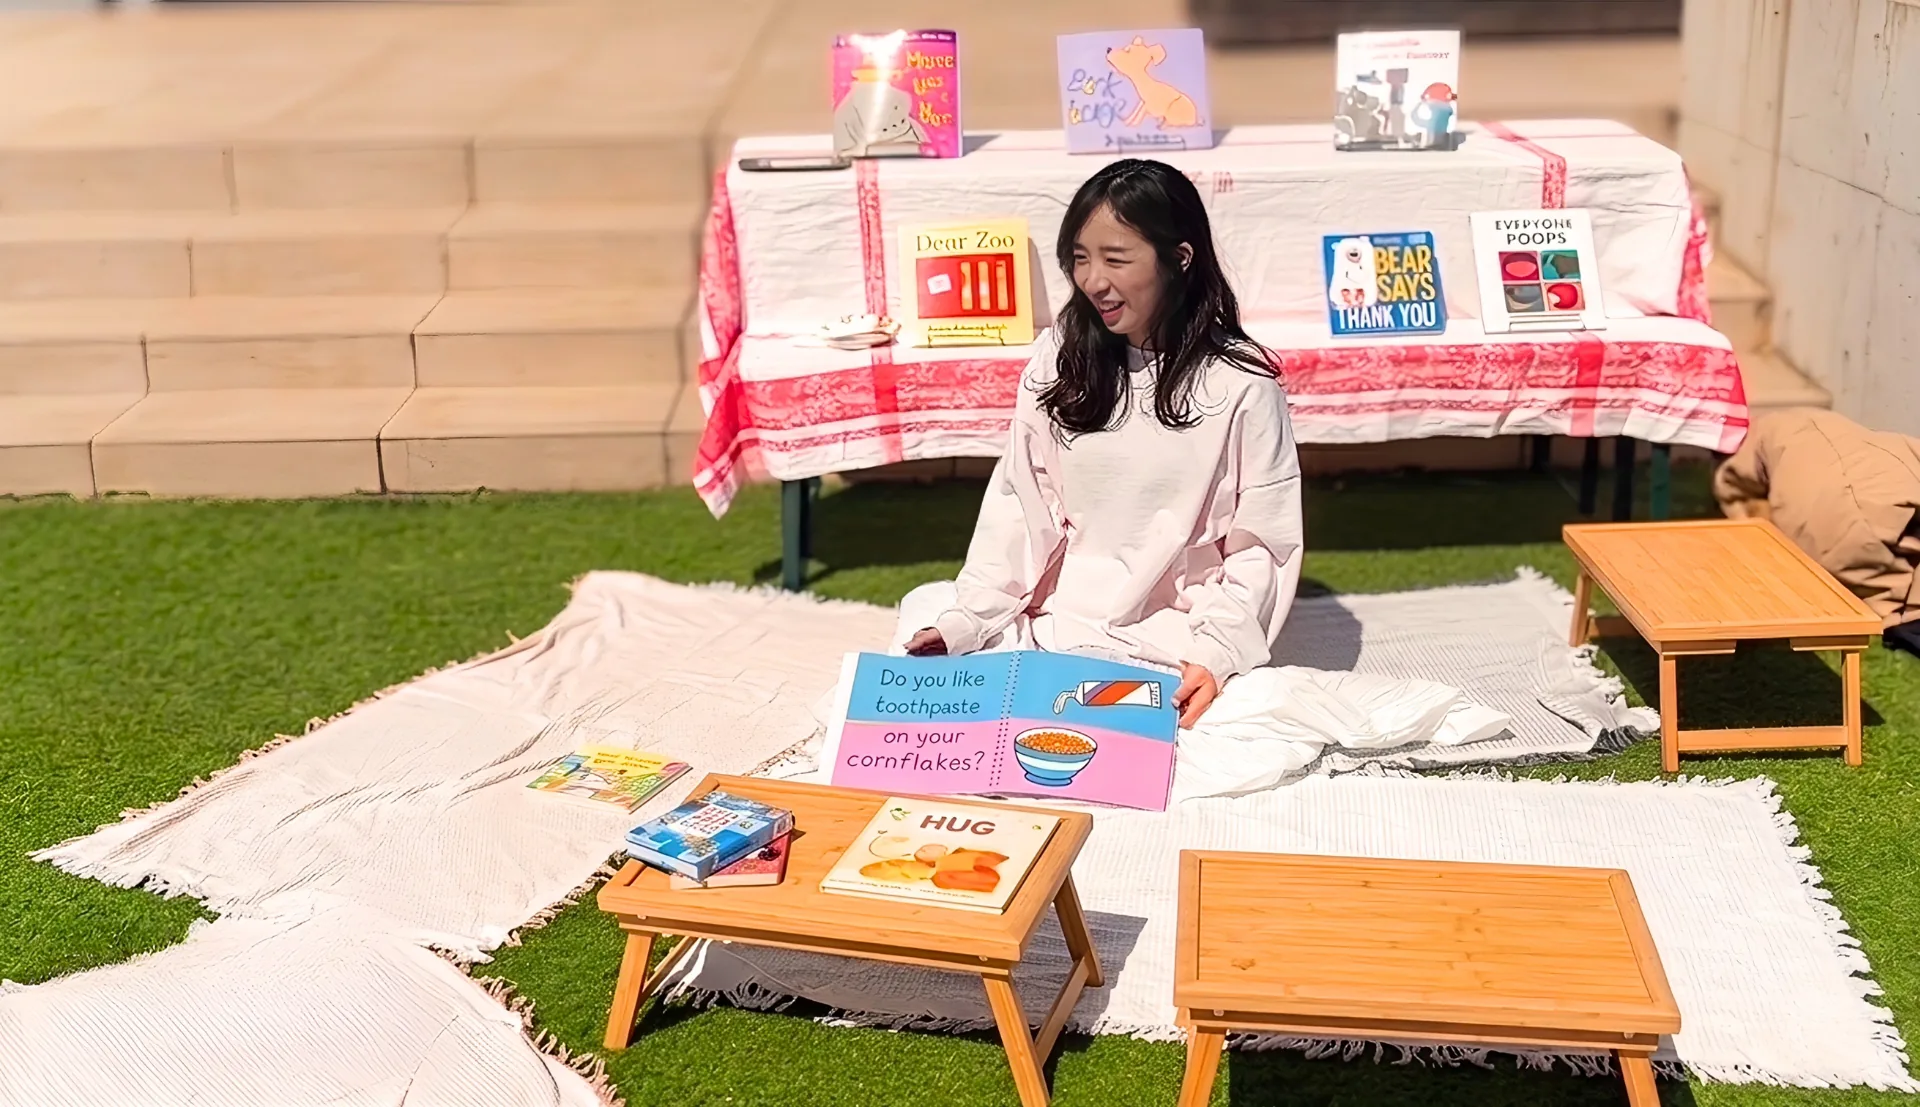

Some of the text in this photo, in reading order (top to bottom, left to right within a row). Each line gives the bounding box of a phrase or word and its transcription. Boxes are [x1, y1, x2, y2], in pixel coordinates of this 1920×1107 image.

[916, 231, 1015, 252] Dear Zoo
[1506, 232, 1567, 246] POOPS
[1374, 245, 1433, 274] BEAR
[1377, 272, 1436, 303] SAYS
[1338, 301, 1437, 330] THANK YOU
[880, 668, 986, 692] Do you like
[876, 695, 981, 719] toothpaste
[883, 731, 966, 749] on your
[846, 750, 986, 772] cornflakes?
[919, 814, 996, 836] HUG
